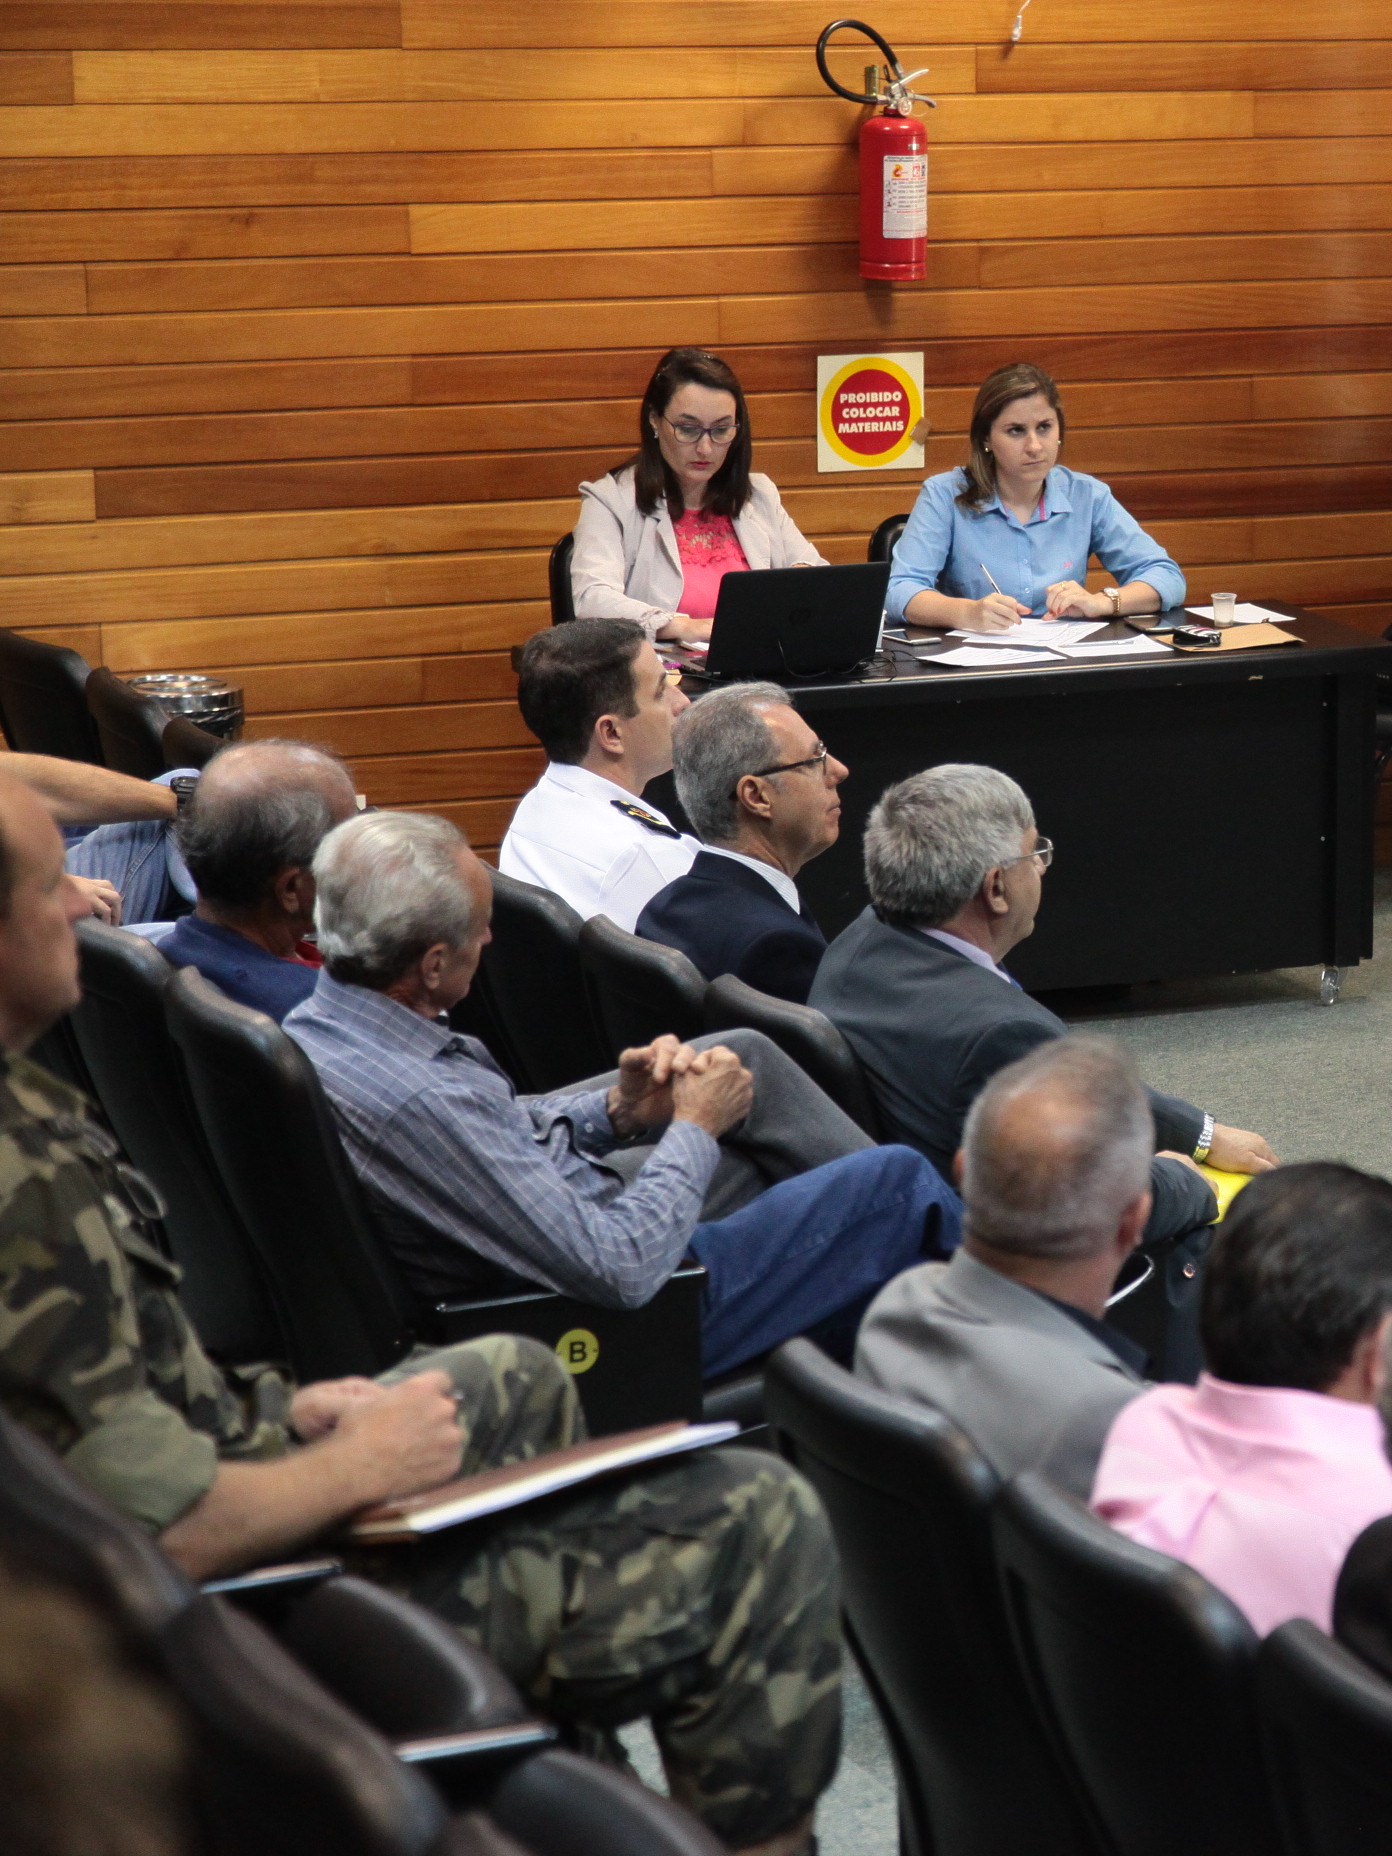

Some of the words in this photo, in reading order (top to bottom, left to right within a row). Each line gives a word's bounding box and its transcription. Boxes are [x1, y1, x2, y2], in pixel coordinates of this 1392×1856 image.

[840, 391, 902, 404] PROIBIDO
[842, 406, 900, 419] COLOCAR
[838, 421, 904, 434] MATERIAIS
[569, 1341, 587, 1363] B
